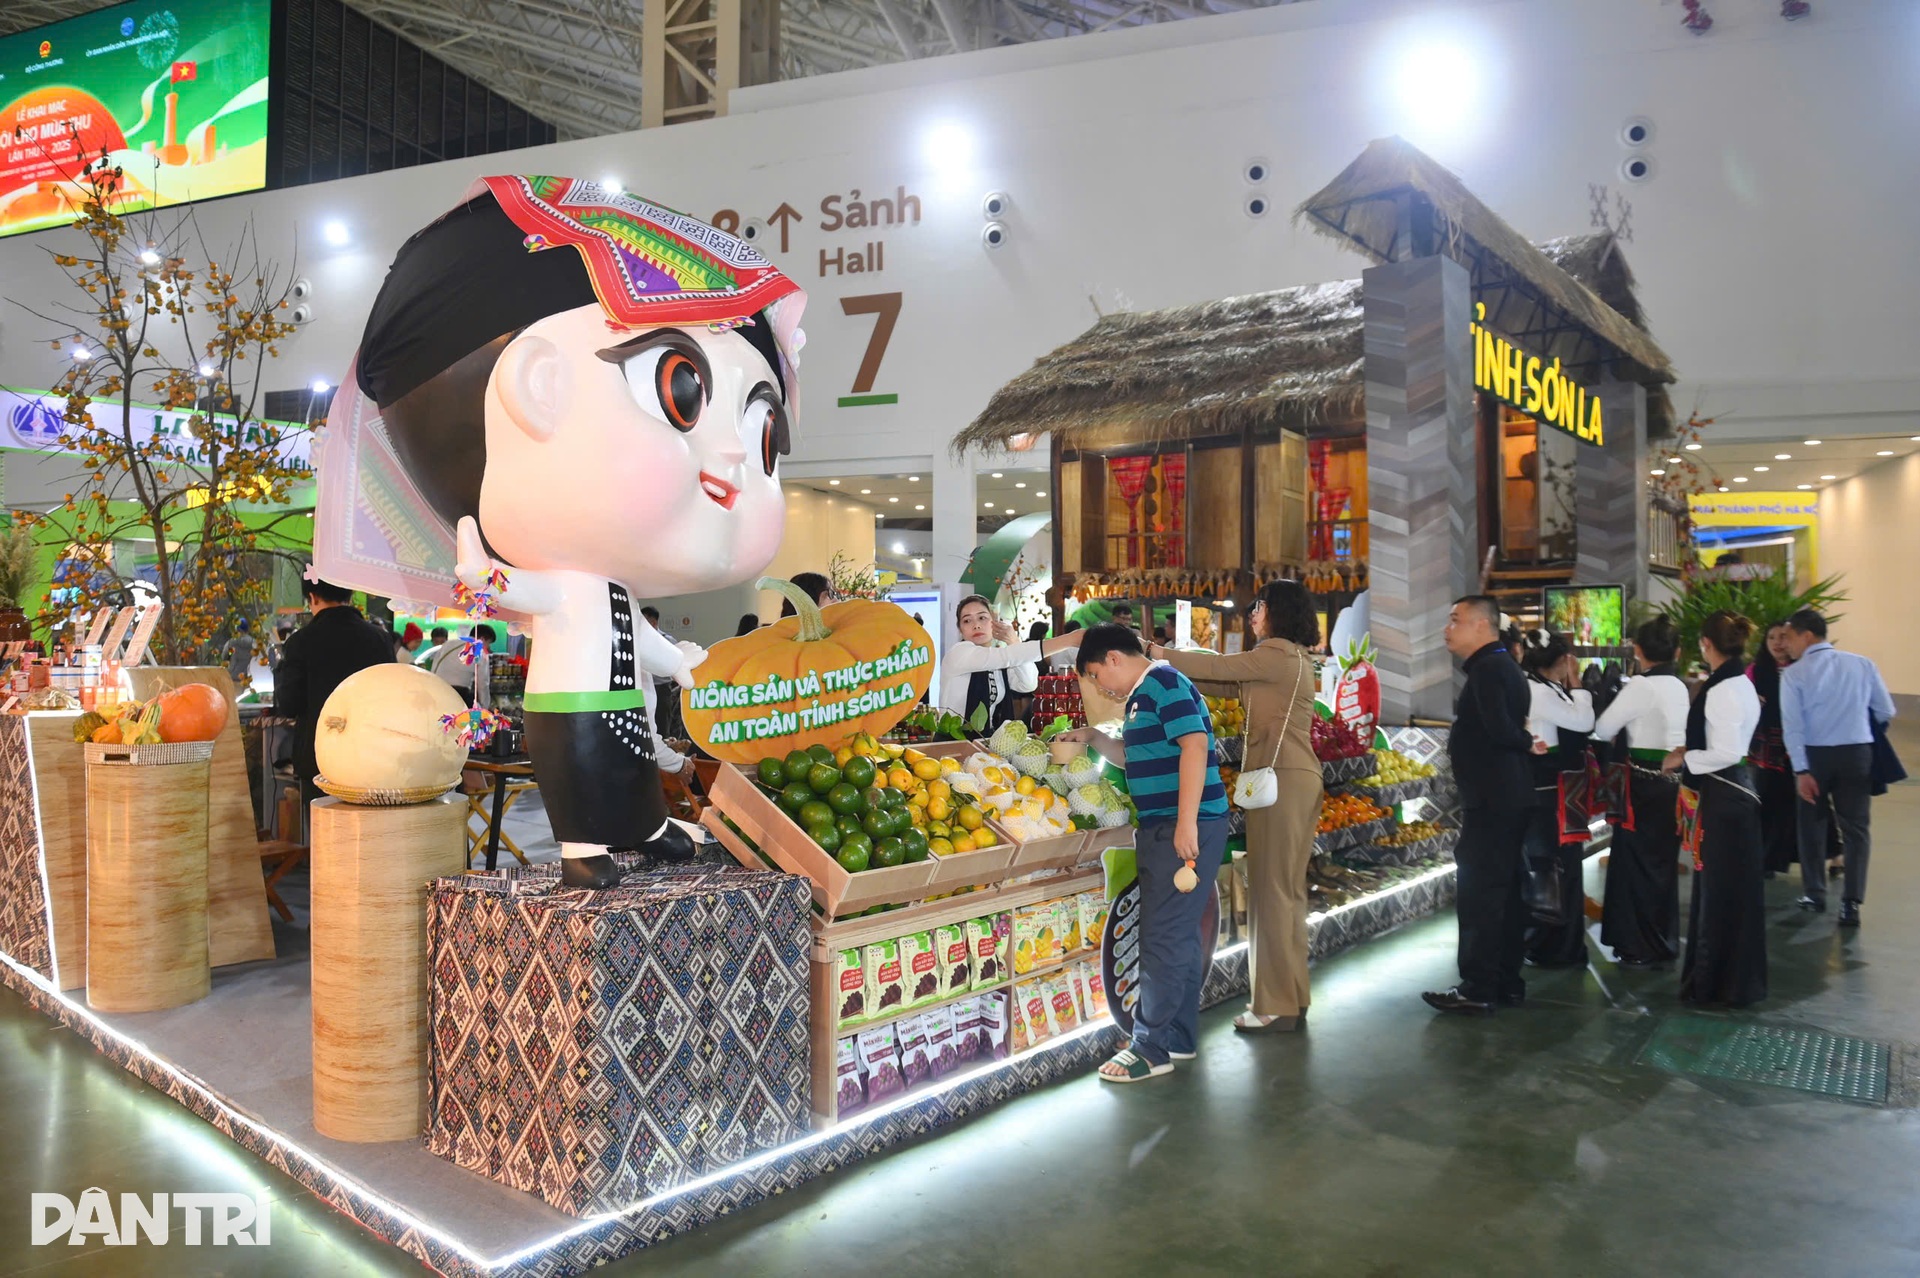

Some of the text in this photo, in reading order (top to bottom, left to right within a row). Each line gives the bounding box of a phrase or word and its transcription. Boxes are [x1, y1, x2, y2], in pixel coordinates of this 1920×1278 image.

[27, 105, 46, 119] KHAI
[69, 113, 91, 132] THU
[51, 139, 71, 154] 2025
[819, 185, 921, 232] Sảnh
[819, 241, 884, 278] Hall
[839, 291, 903, 394] 7
[1469, 302, 1523, 405] ỈNH
[1577, 386, 1604, 446] LA
[689, 638, 930, 710] NÔNG SẢN VÀ THỰC PHẨM
[708, 681, 915, 744] AN TOÀN TỈNH SƠN LA
